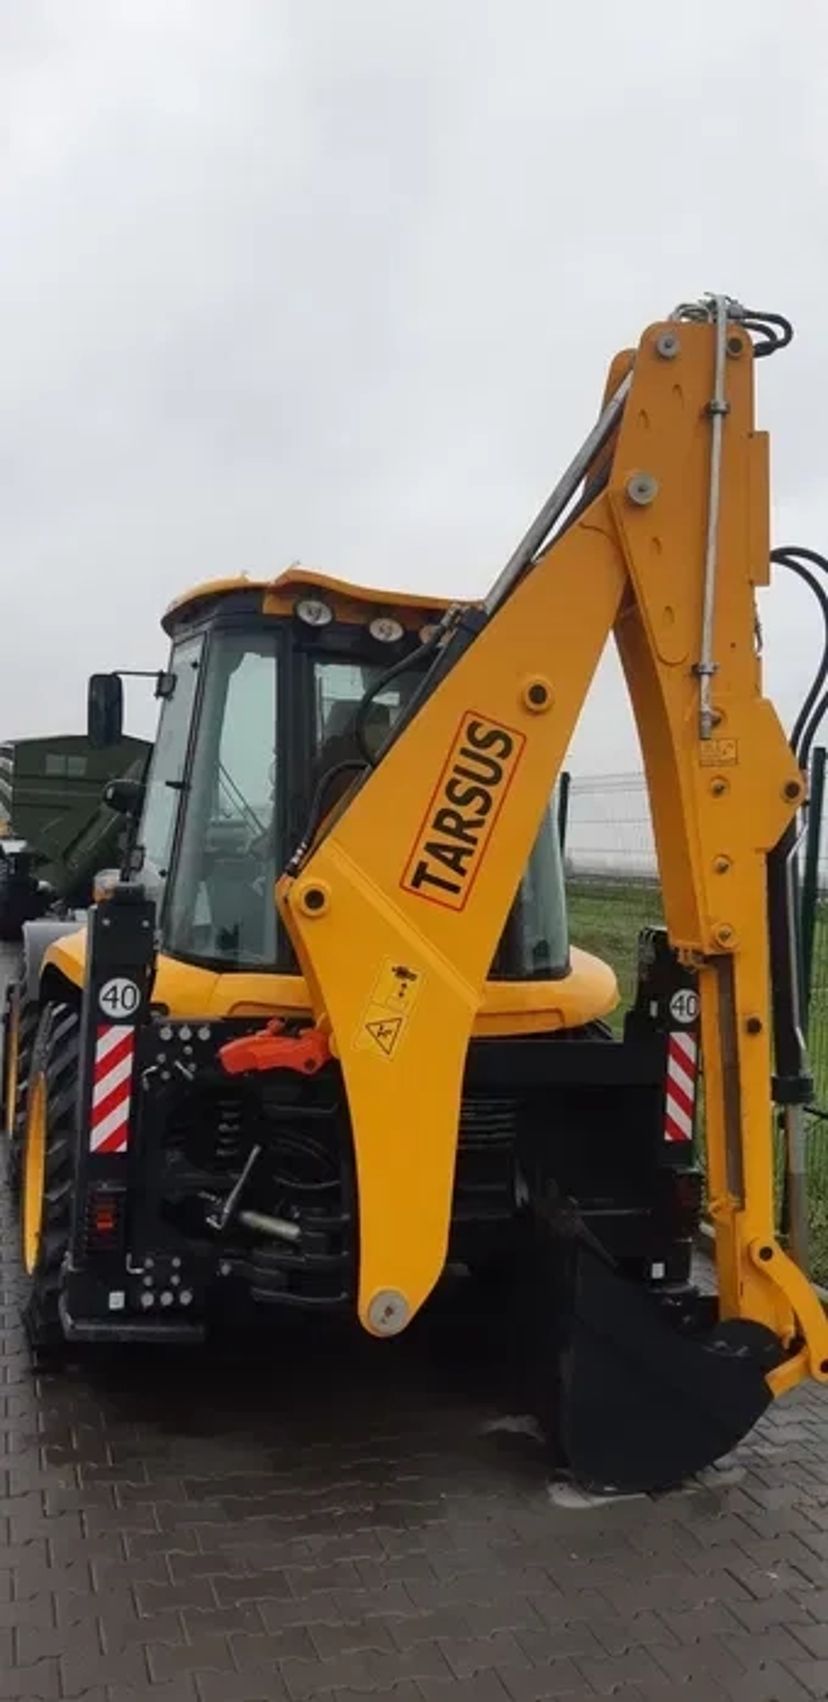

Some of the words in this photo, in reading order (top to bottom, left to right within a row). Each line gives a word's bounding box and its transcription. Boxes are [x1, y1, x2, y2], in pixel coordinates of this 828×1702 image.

[411, 720, 513, 894] TARSUS
[102, 985, 137, 1010] 40
[672, 995, 697, 1016] 40
